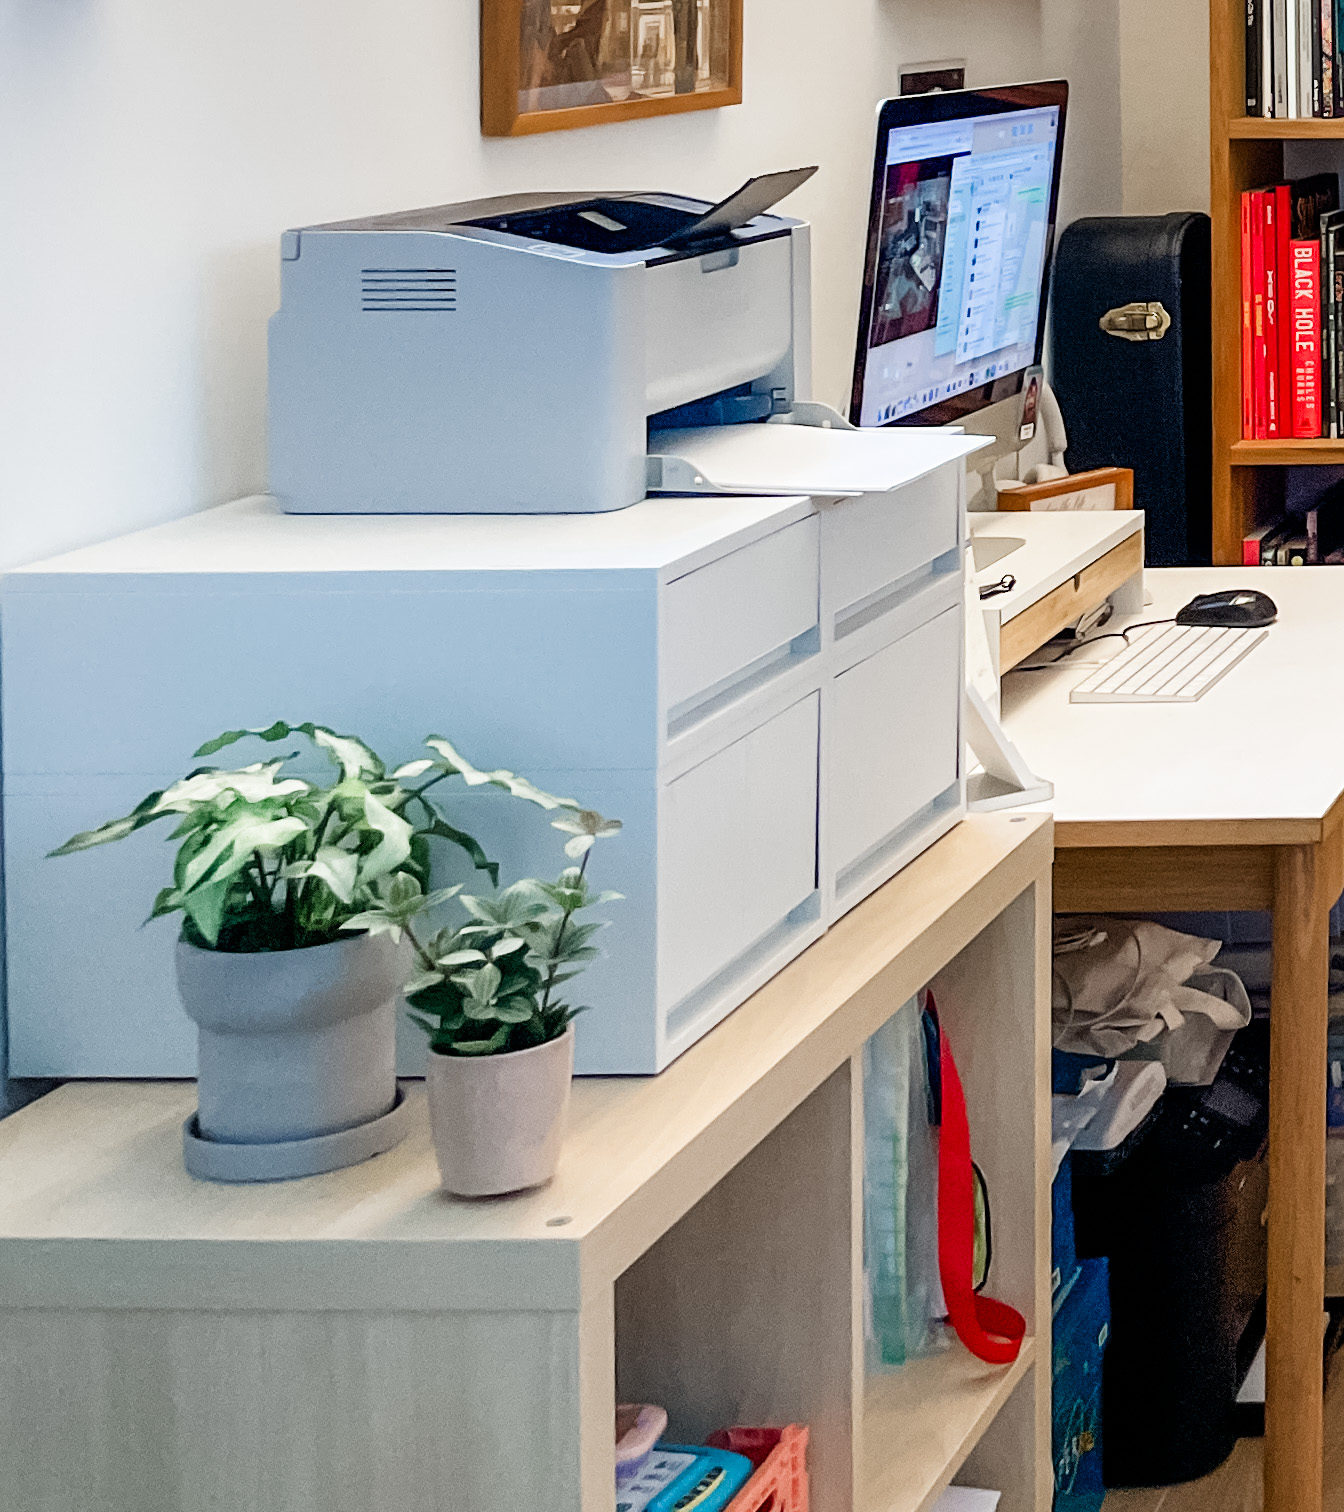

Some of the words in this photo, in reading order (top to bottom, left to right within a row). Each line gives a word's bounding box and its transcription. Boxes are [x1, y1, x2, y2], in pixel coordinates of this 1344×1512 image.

[1294, 248, 1313, 299] BLACK
[1295, 308, 1314, 352] HOLE
[1305, 361, 1314, 408] CHARLES
